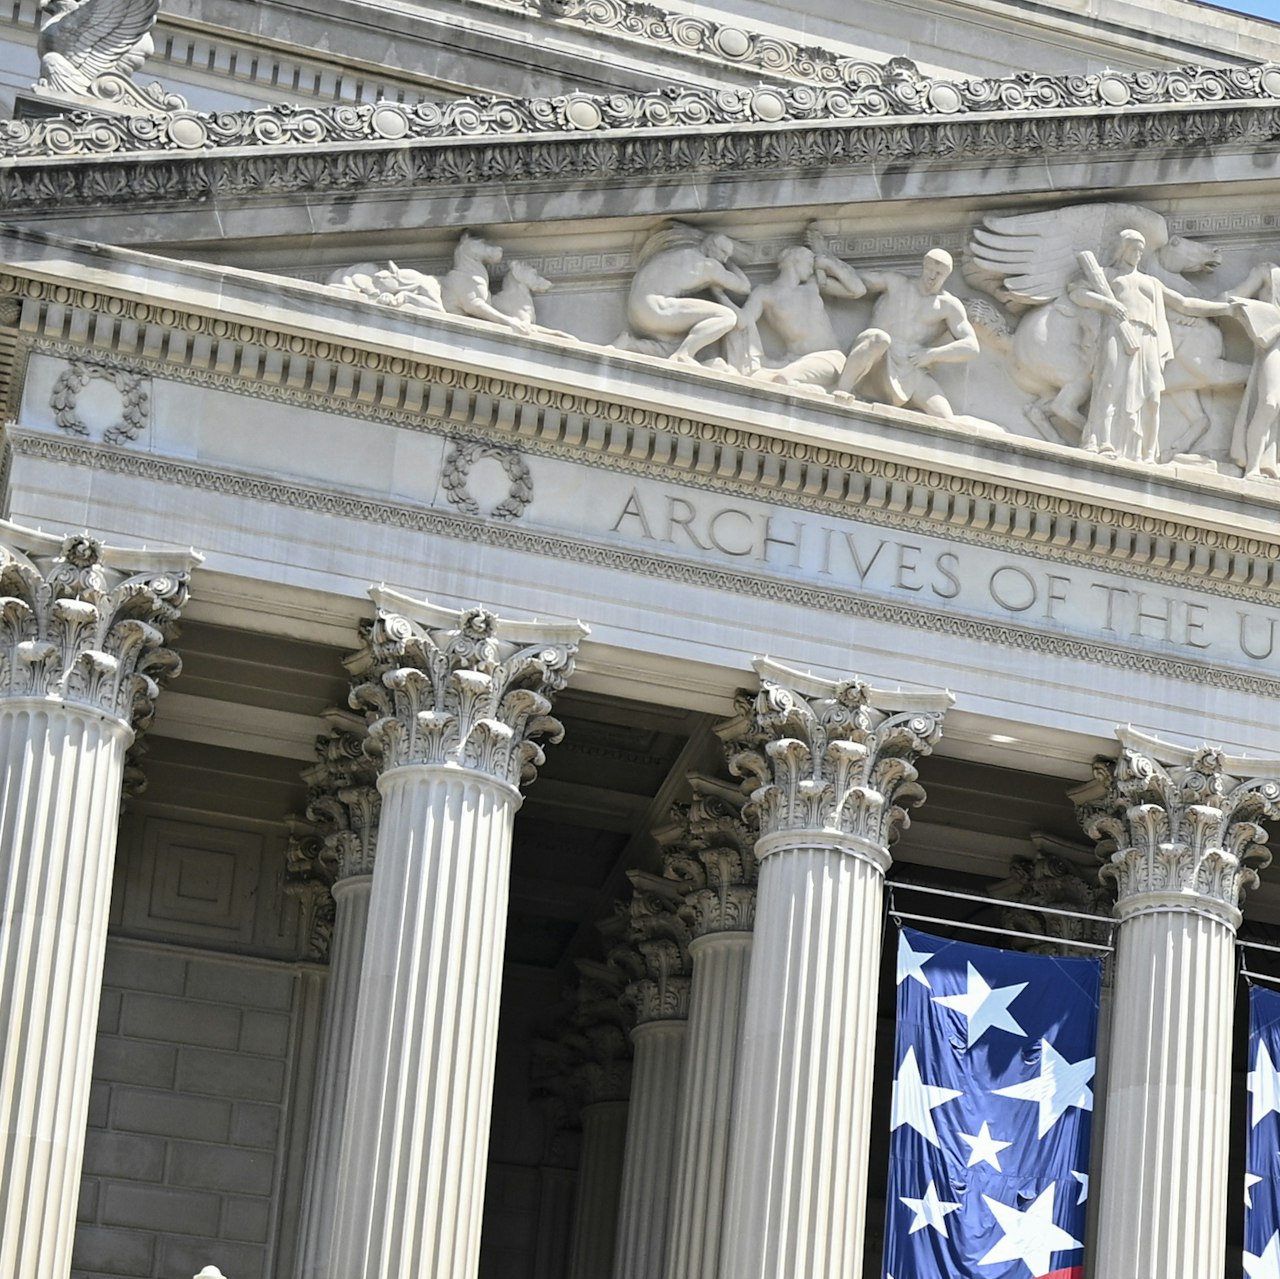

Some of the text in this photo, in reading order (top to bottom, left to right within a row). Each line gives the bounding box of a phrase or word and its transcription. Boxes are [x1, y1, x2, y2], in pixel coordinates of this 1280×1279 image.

[609, 486, 963, 601] ARCHIVES
[989, 565, 1072, 620] OF
[1090, 583, 1212, 650] THE
